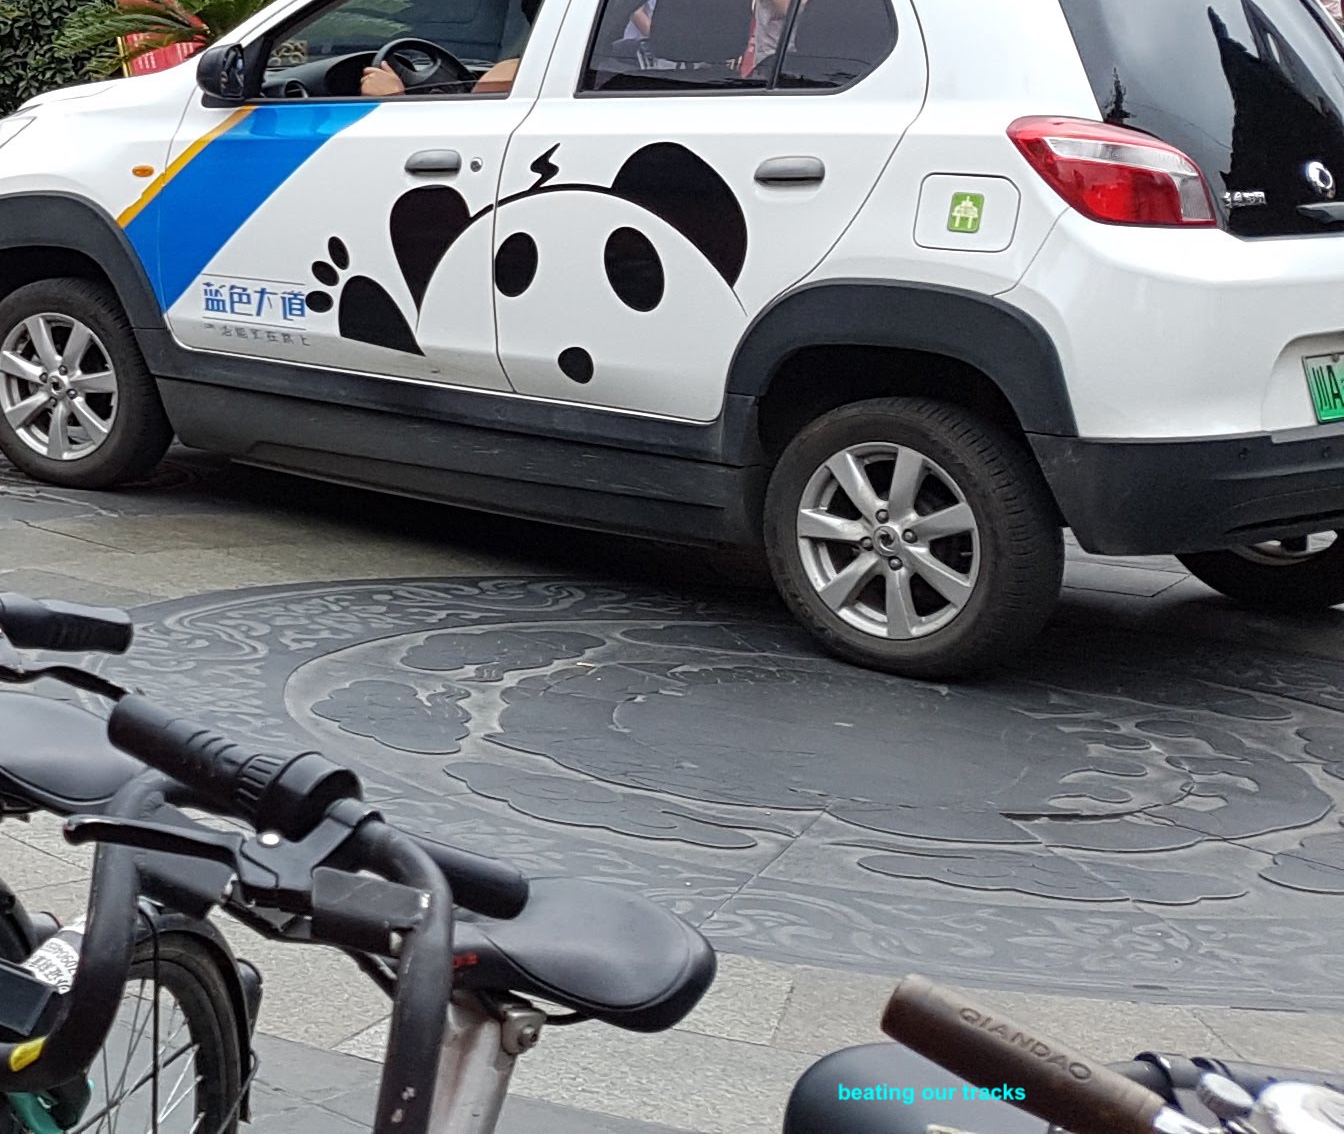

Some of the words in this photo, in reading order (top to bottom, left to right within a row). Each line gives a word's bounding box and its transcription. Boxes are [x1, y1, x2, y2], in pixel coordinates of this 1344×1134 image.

[202, 282, 306, 321] 蓝色大道
[959, 1007, 1093, 1080] QIANDAO
